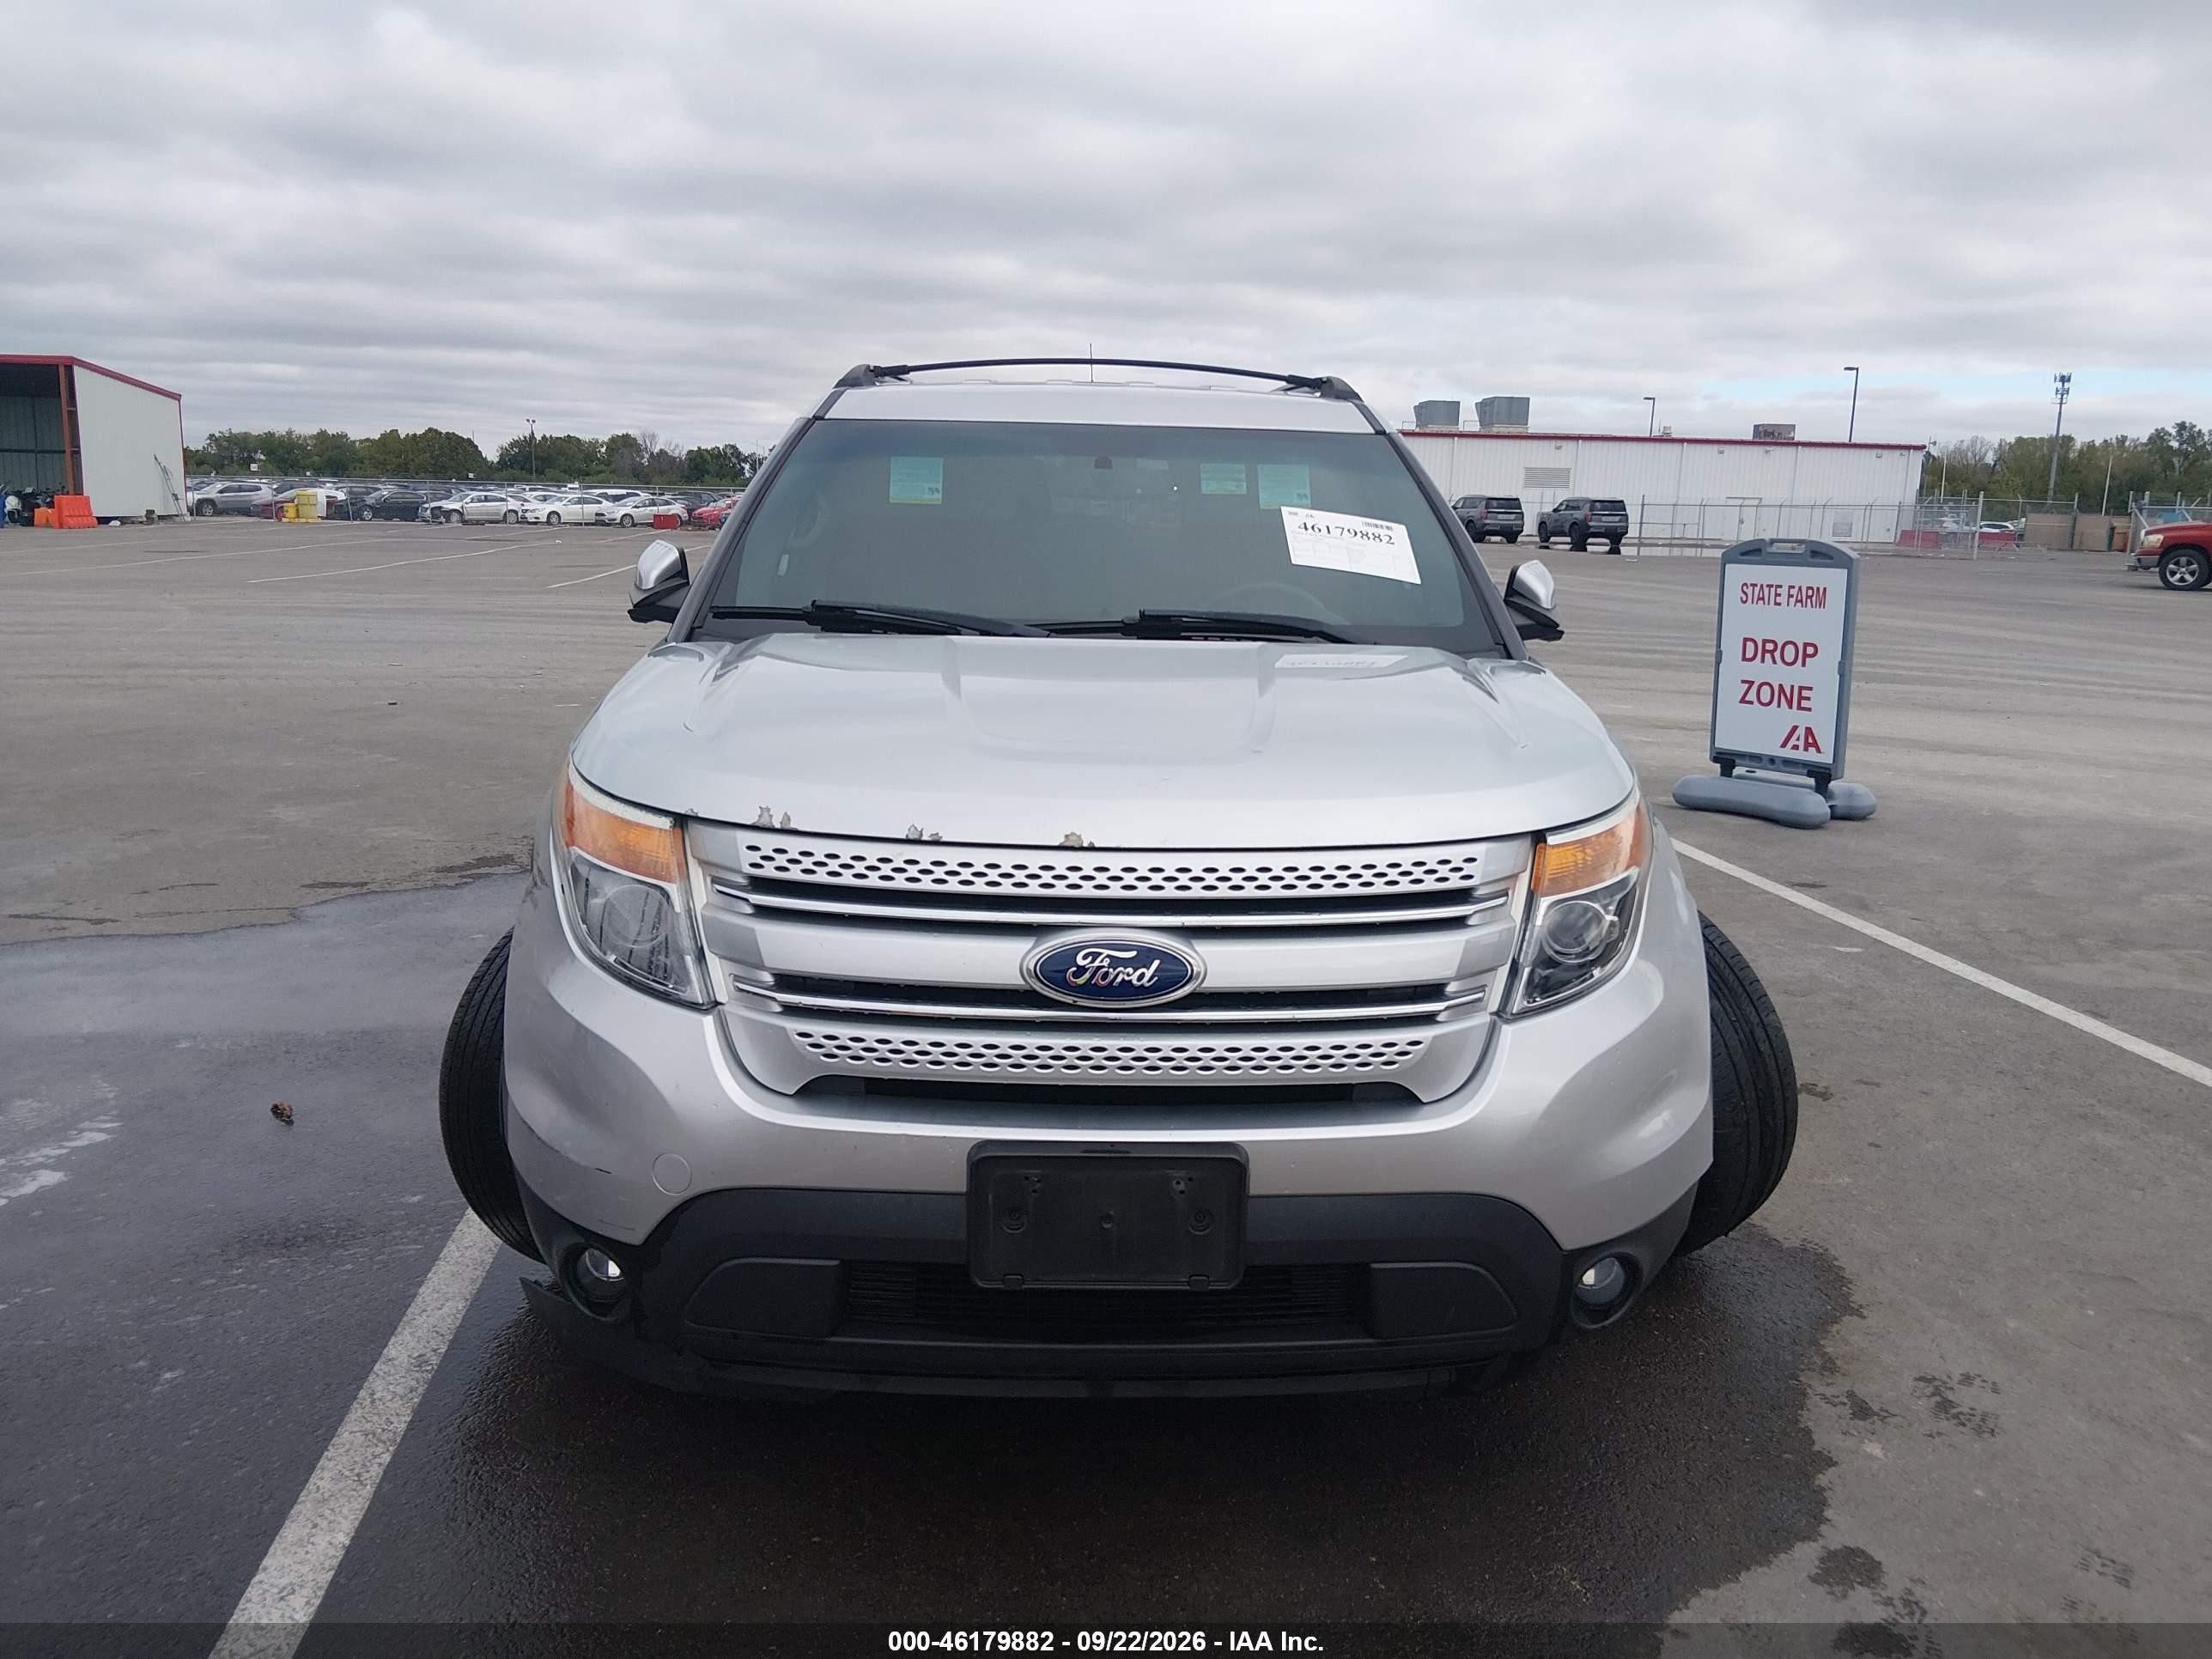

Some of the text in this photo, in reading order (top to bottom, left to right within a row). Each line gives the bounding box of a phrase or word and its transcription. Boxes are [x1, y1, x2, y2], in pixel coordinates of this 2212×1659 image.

[1298, 521, 1395, 545] 46179882
[1740, 582, 1827, 610] STATE FARM
[1741, 637, 1819, 667] DROP
[1739, 679, 1814, 712] ZONE
[1066, 947, 1161, 988] Ford
